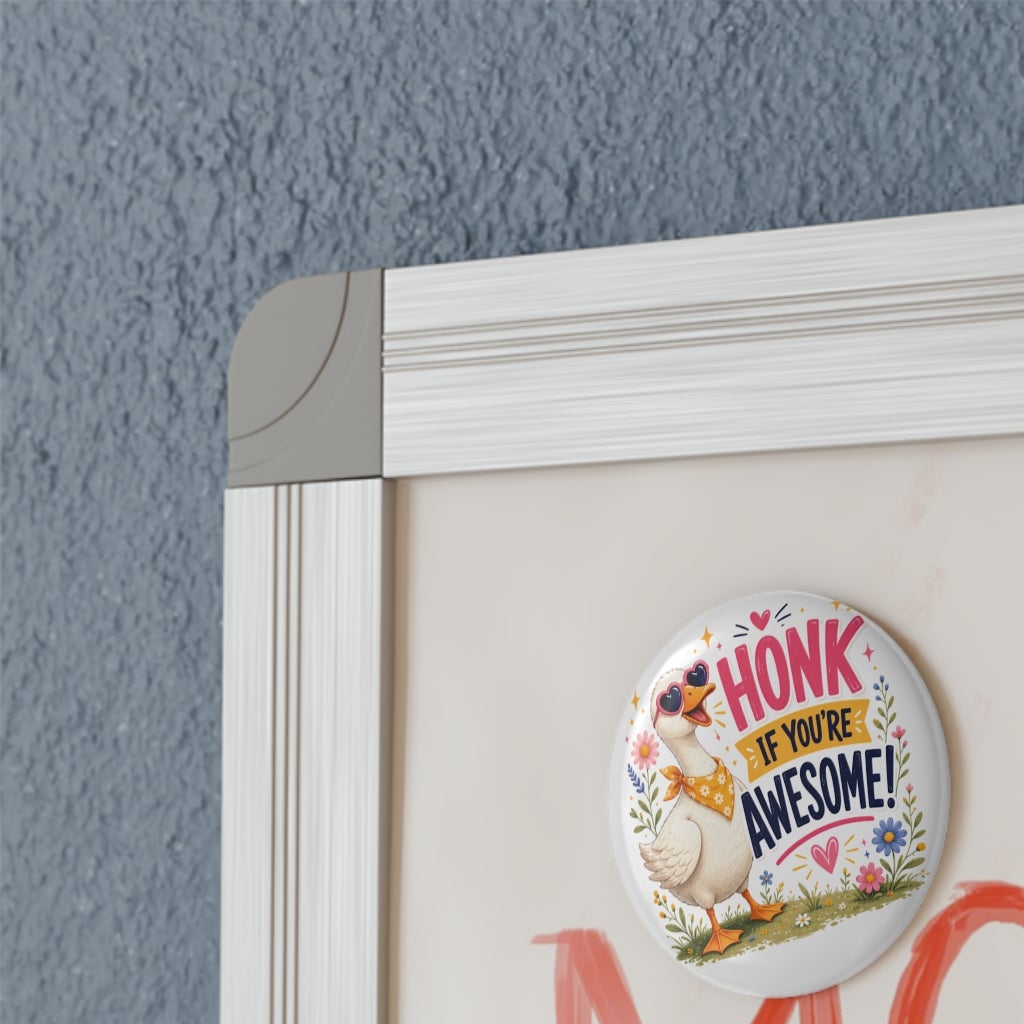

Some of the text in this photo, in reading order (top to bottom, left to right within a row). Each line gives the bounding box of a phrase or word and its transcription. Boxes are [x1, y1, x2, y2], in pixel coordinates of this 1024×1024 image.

[716, 615, 864, 732] HONK
[756, 707, 852, 766] IF YOU'RE
[740, 744, 895, 859] AWESOME!
